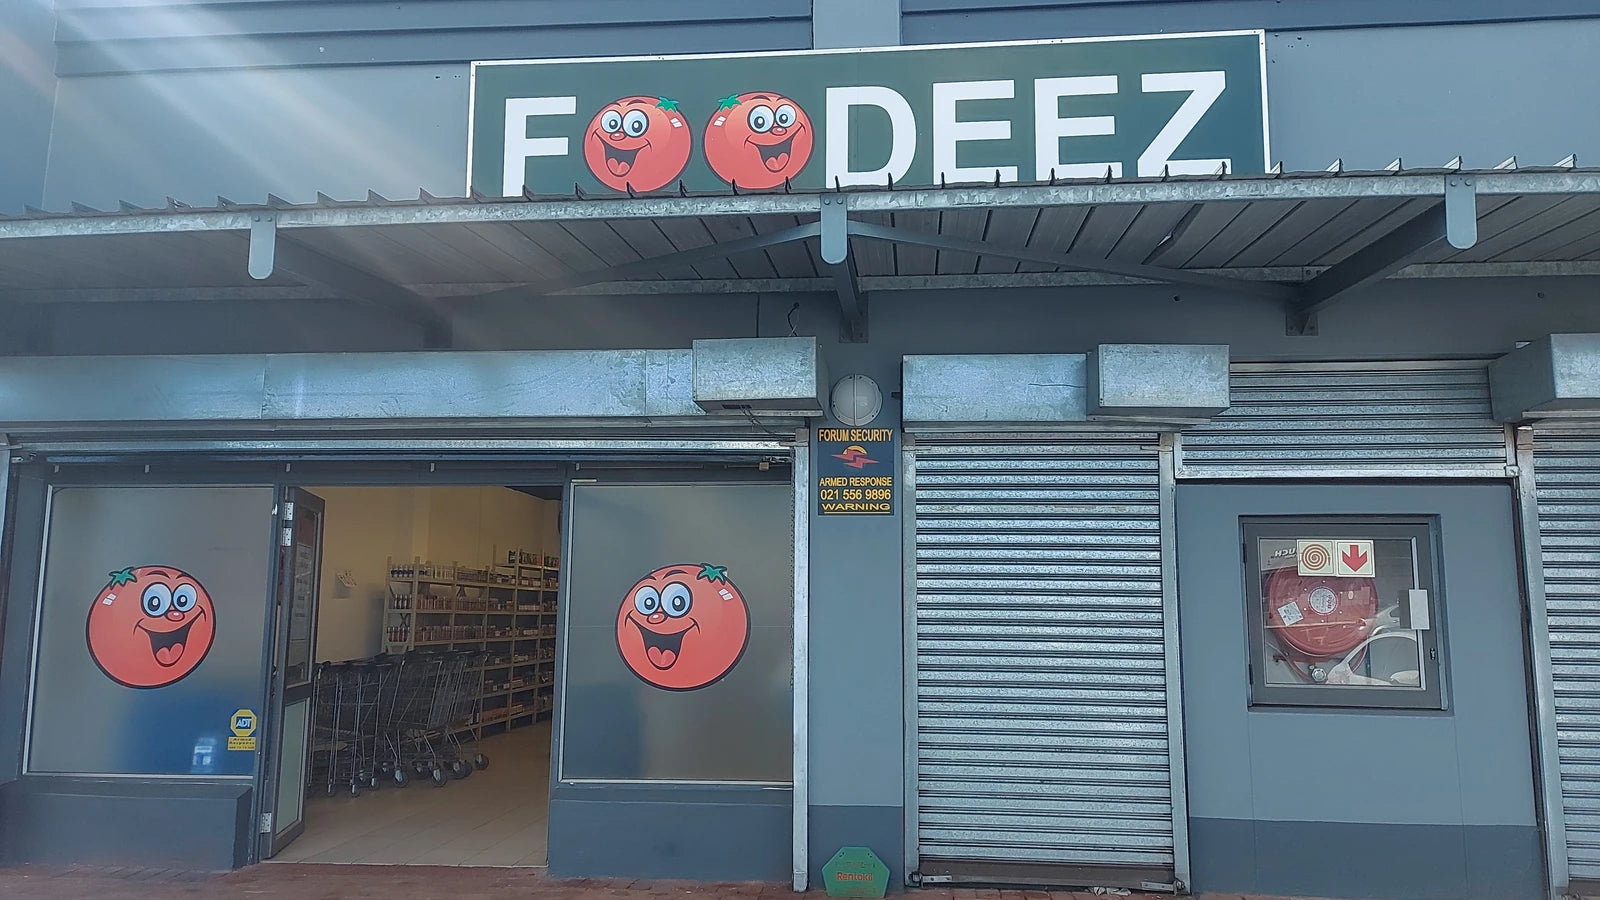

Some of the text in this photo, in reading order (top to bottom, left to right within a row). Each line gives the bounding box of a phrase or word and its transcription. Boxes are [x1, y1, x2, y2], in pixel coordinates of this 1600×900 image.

[818, 429, 893, 442] FORUM SECURITY
[819, 477, 893, 487] ARMED RESPONSE
[820, 489, 891, 500] 021 556 9896
[821, 503, 891, 511] WARNING
[235, 718, 252, 728] ADT
